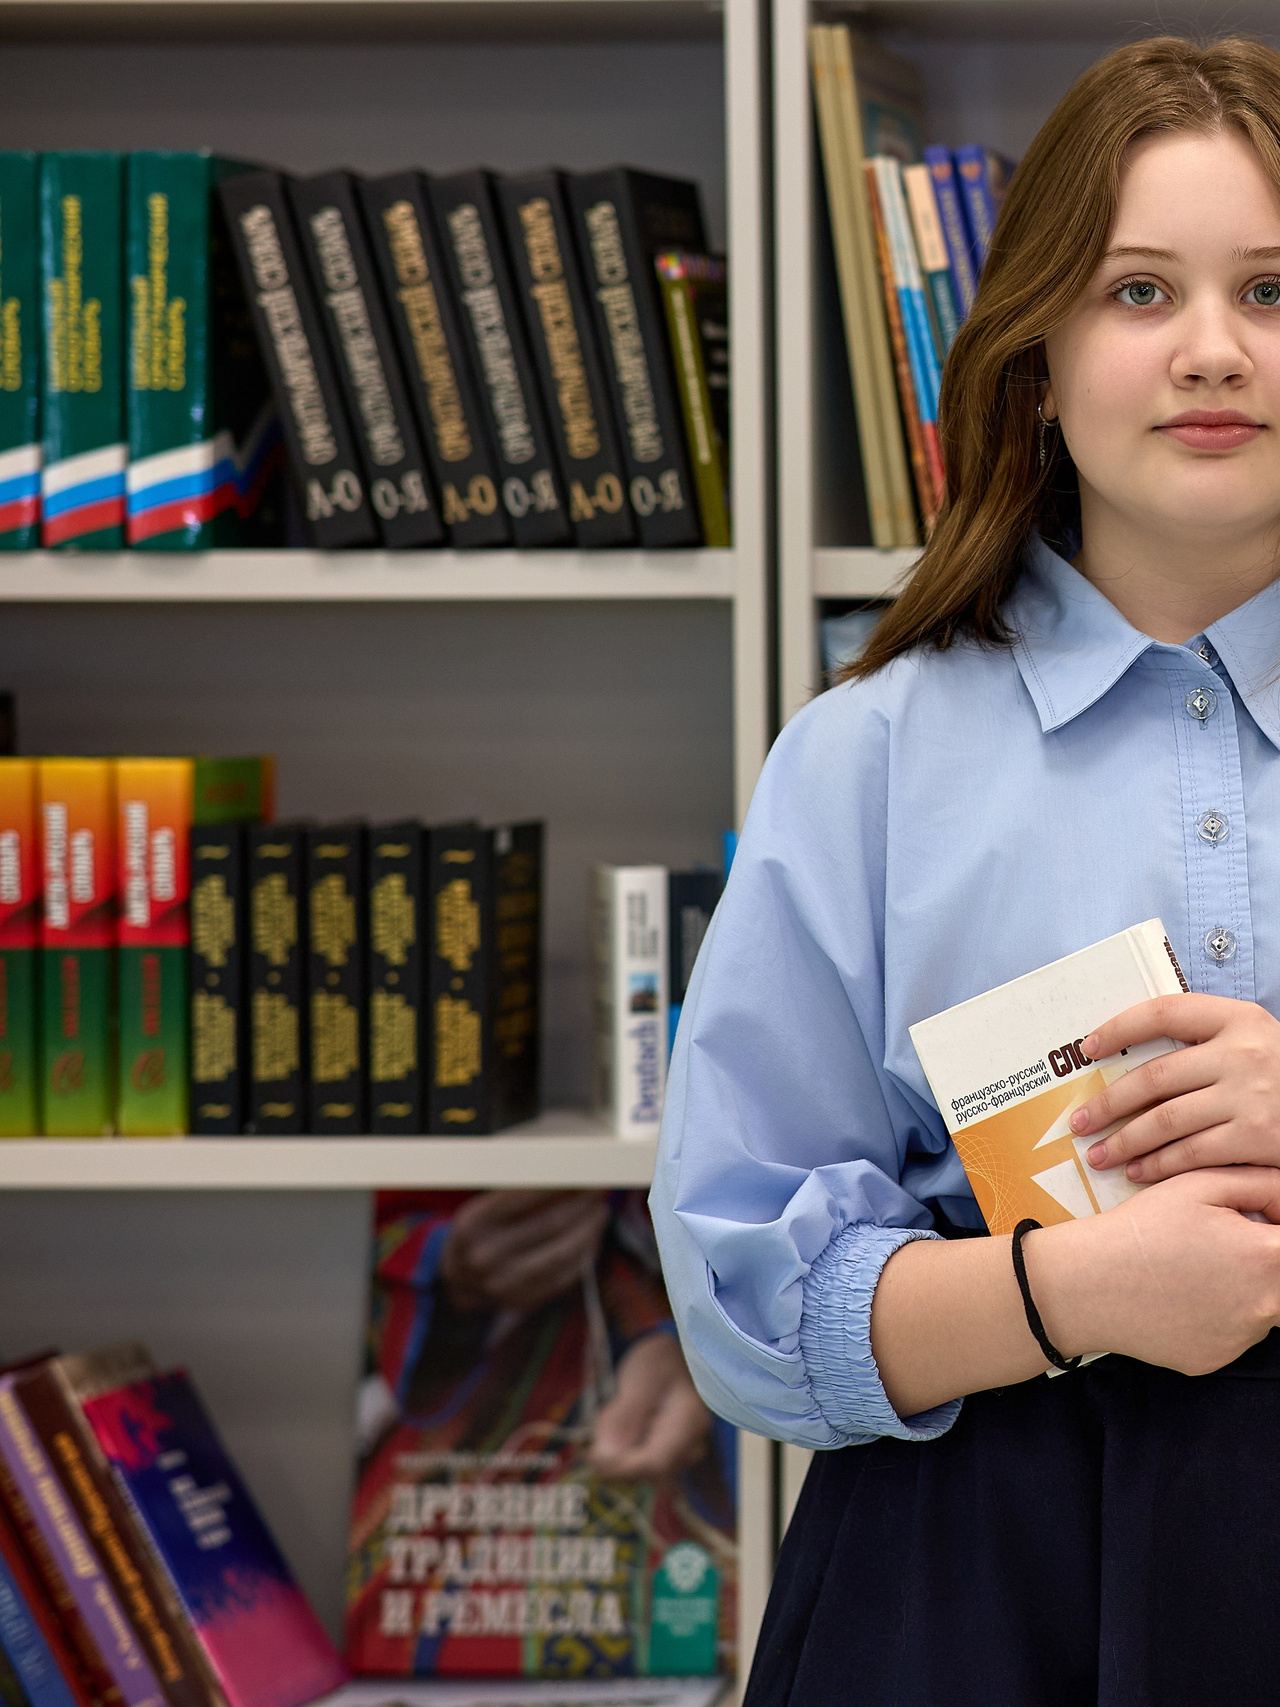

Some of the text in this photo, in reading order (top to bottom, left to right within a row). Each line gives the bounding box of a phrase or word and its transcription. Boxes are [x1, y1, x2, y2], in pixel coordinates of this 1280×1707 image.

[951, 1059, 1047, 1112] французско-русский
[955, 1071, 1052, 1124] русско-французский
[388, 1484, 590, 1531] ДРЕВНИЕ
[386, 1536, 617, 1583] ТРАДИЦИИ
[380, 1591, 414, 1636] И
[422, 1591, 625, 1634] РЕМЕСЛА
